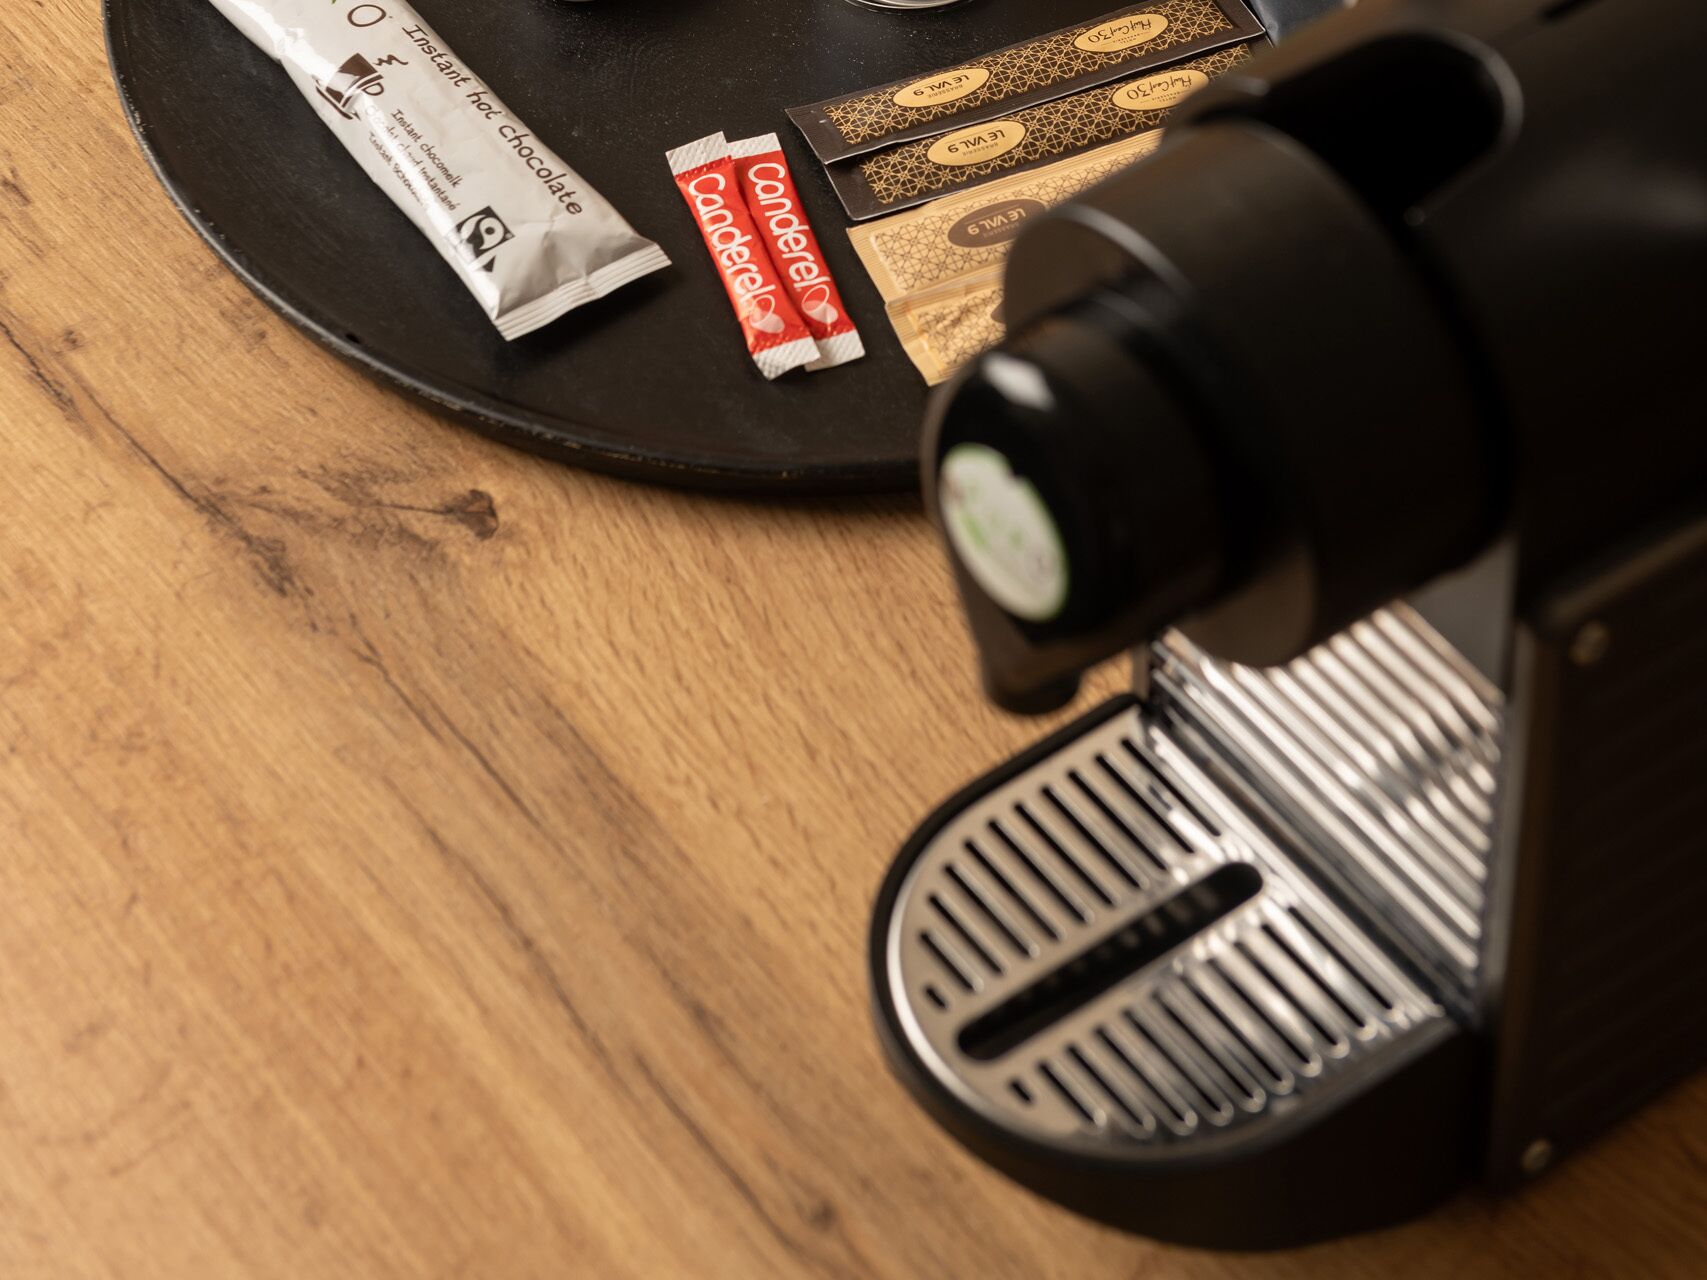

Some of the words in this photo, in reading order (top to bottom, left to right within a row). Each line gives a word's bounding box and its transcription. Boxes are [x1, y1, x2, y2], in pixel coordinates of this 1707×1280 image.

[951, 74, 971, 84] LE
[925, 80, 952, 92] VAL
[913, 88, 925, 97] 9
[401, 24, 468, 88] Instant
[466, 91, 503, 120] hot
[498, 124, 583, 215] chocolate
[988, 129, 1006, 140] LE
[960, 134, 988, 148] VAL
[390, 108, 424, 143] Instant
[420, 142, 463, 189] chocomelk
[947, 143, 959, 154] 9
[1009, 208, 1027, 220] LE
[747, 162, 831, 290] Canderel
[979, 214, 1009, 230] VAL
[967, 224, 980, 235] 9
[688, 173, 776, 305] Canderel
